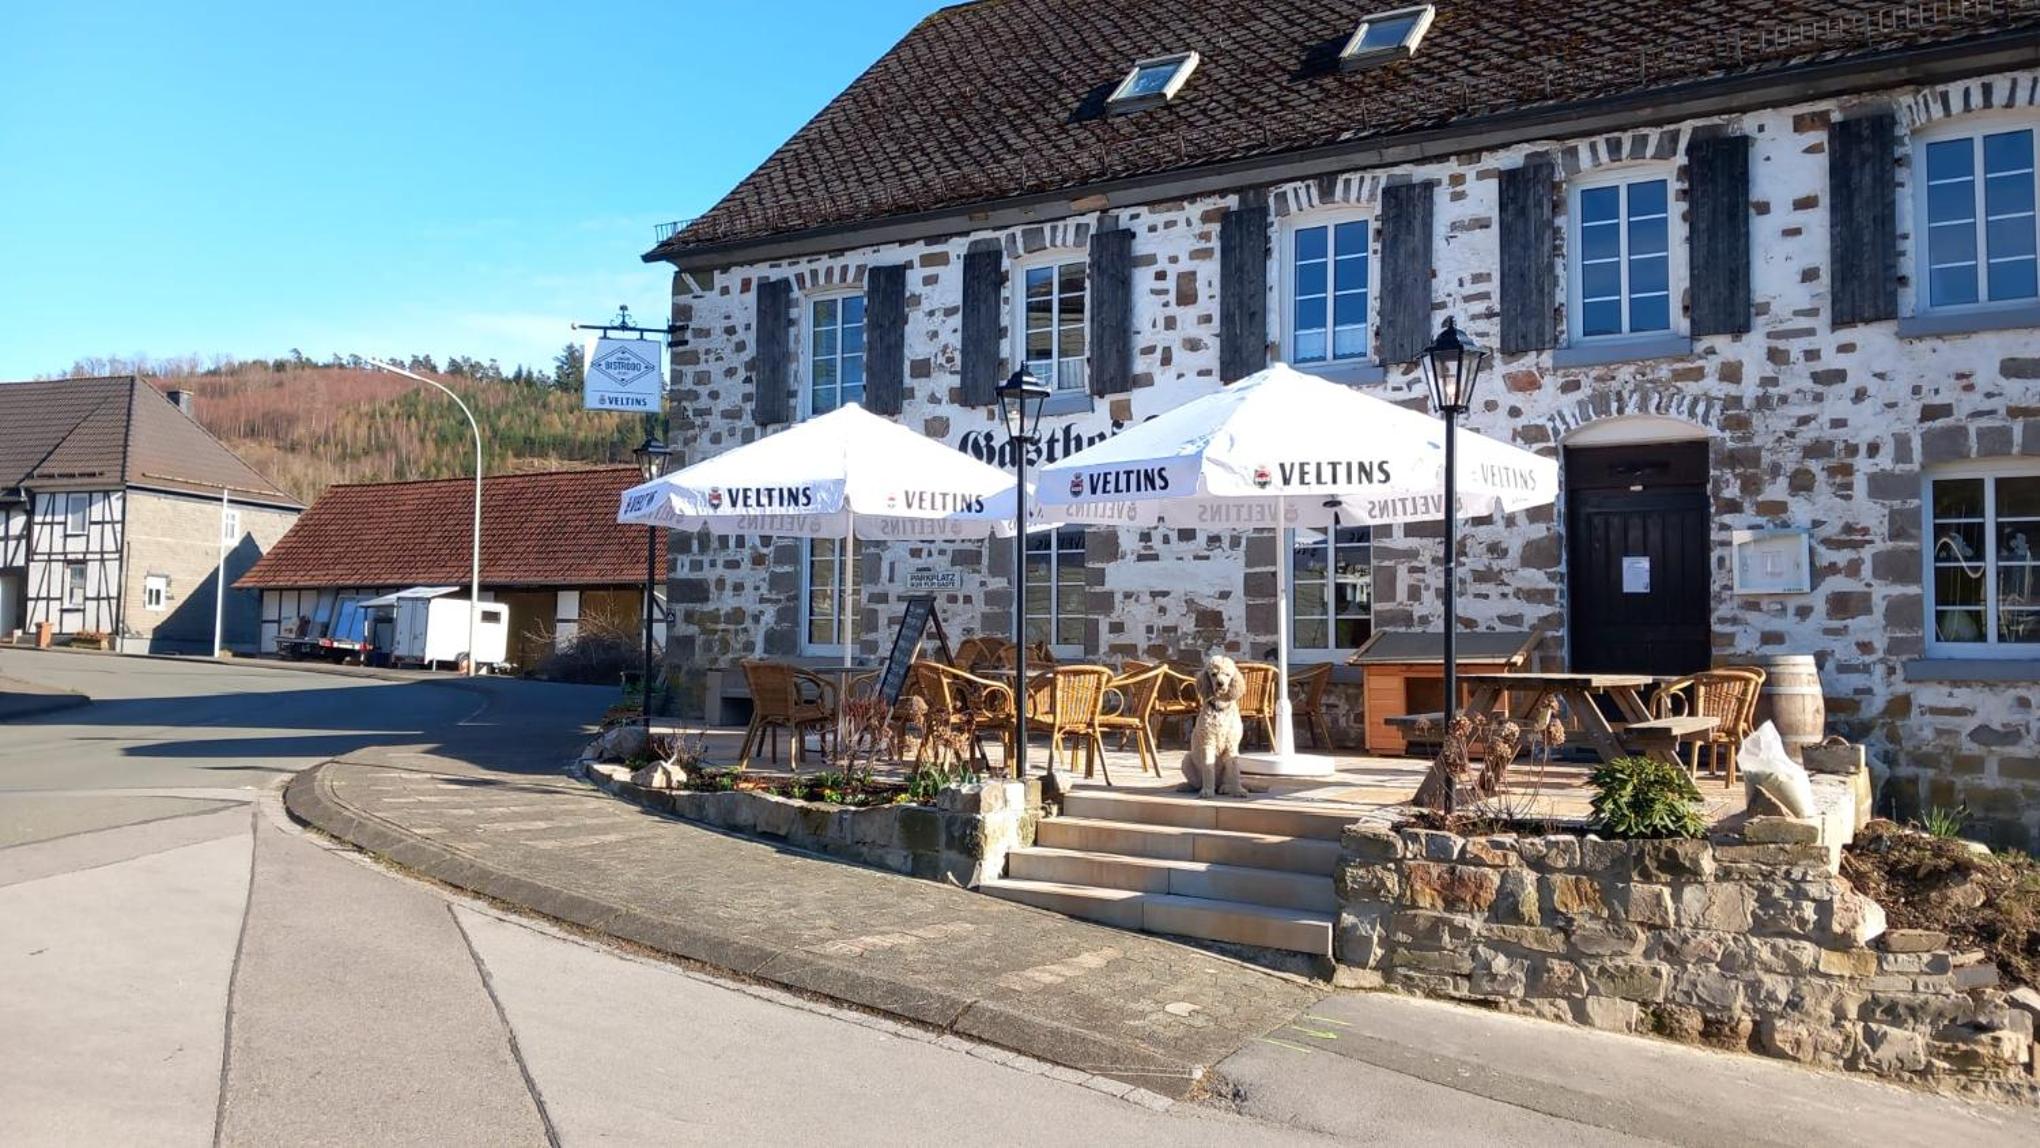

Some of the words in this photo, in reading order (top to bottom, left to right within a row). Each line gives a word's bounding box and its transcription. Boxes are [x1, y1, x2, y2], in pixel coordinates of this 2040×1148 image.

[608, 396, 648, 407] VELTINS
[1088, 467, 1169, 495] VELTINS
[1280, 461, 1391, 486] VELTINS
[1481, 463, 1537, 491] VELTINS
[728, 487, 812, 508] VELTINS
[904, 490, 984, 514] VELTINS
[910, 573, 955, 581] PARKPLATZ
